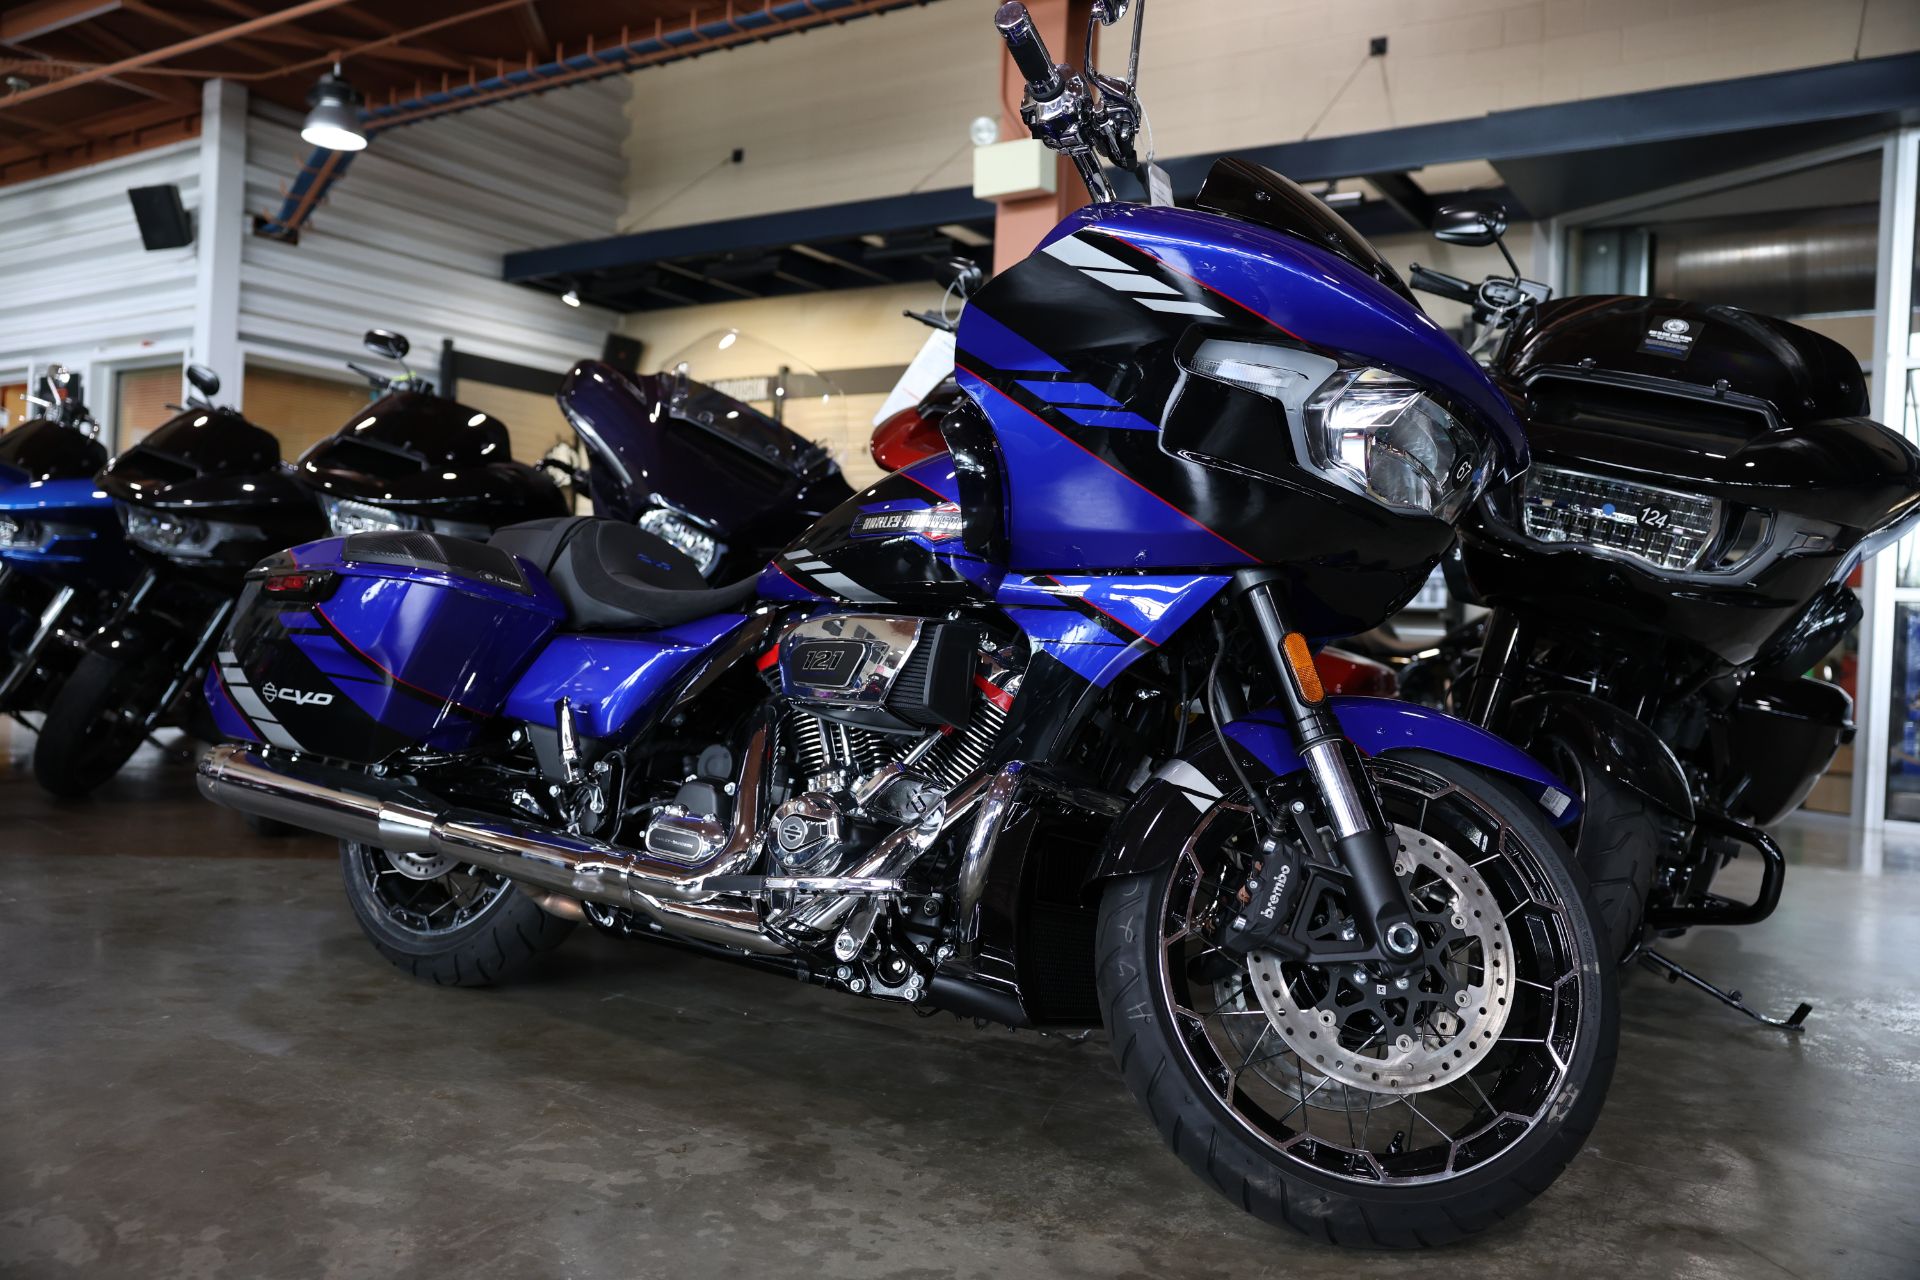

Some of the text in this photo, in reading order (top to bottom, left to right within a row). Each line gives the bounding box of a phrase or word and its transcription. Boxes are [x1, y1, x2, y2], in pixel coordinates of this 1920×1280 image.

[1640, 507, 1669, 529] 124
[802, 650, 845, 670] 121
[278, 687, 335, 706] CVO
[1260, 864, 1291, 919] brembo
